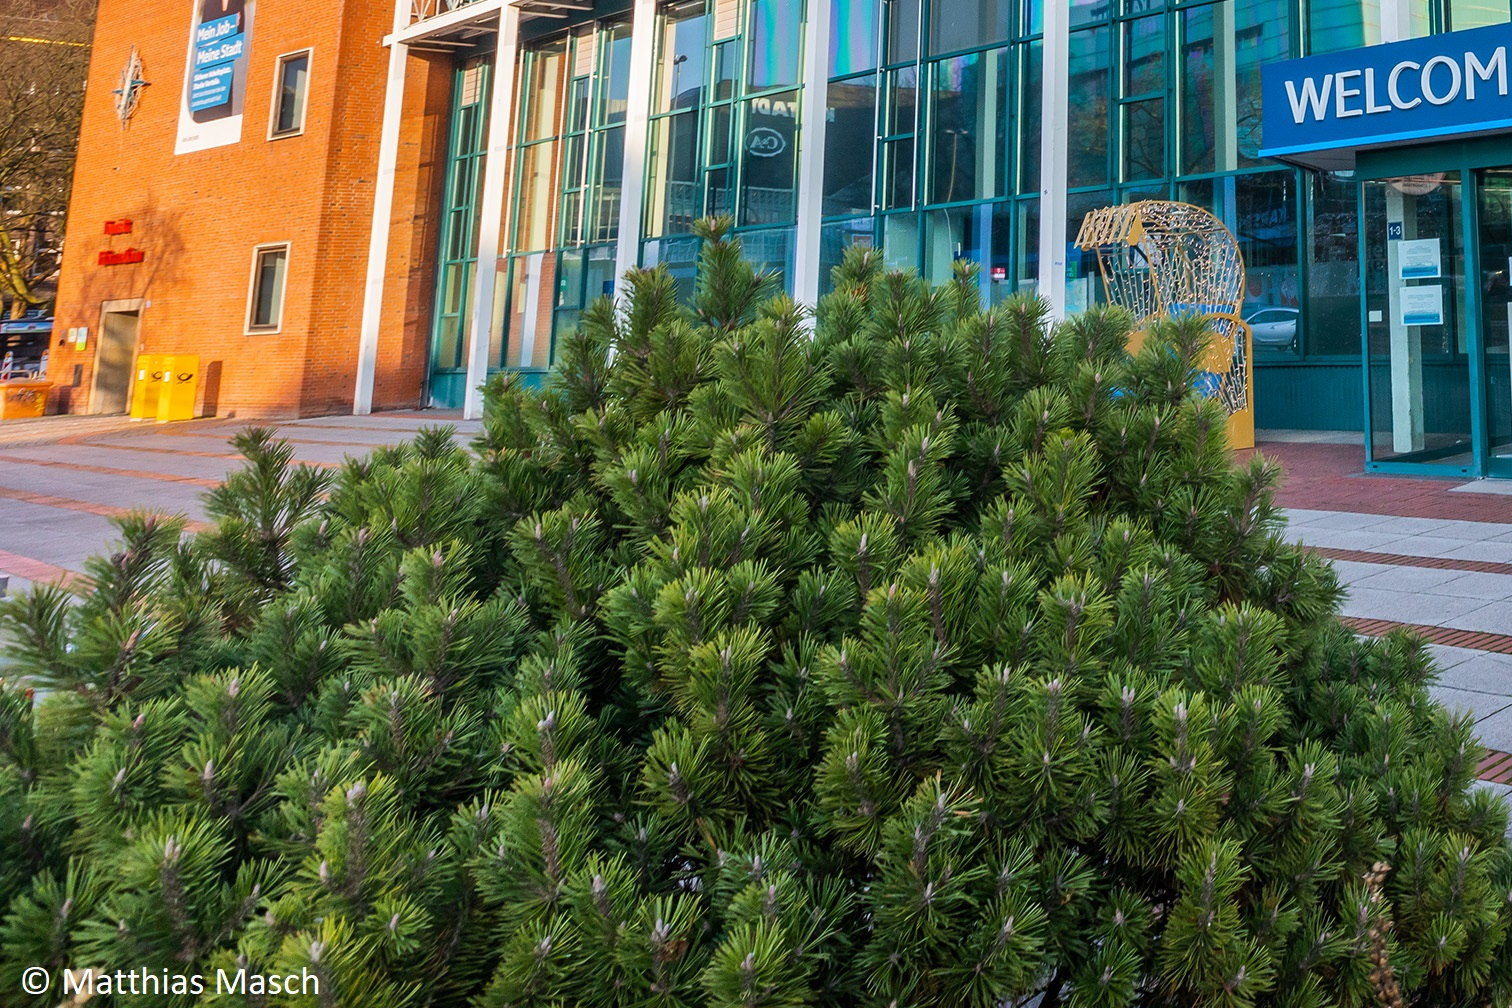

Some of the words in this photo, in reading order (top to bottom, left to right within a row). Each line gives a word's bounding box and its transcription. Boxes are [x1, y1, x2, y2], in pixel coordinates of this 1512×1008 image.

[197, 25, 216, 43] Mein
[197, 47, 220, 64] Meine
[220, 40, 243, 59] Stadt
[1389, 226, 1401, 236] 1-3
